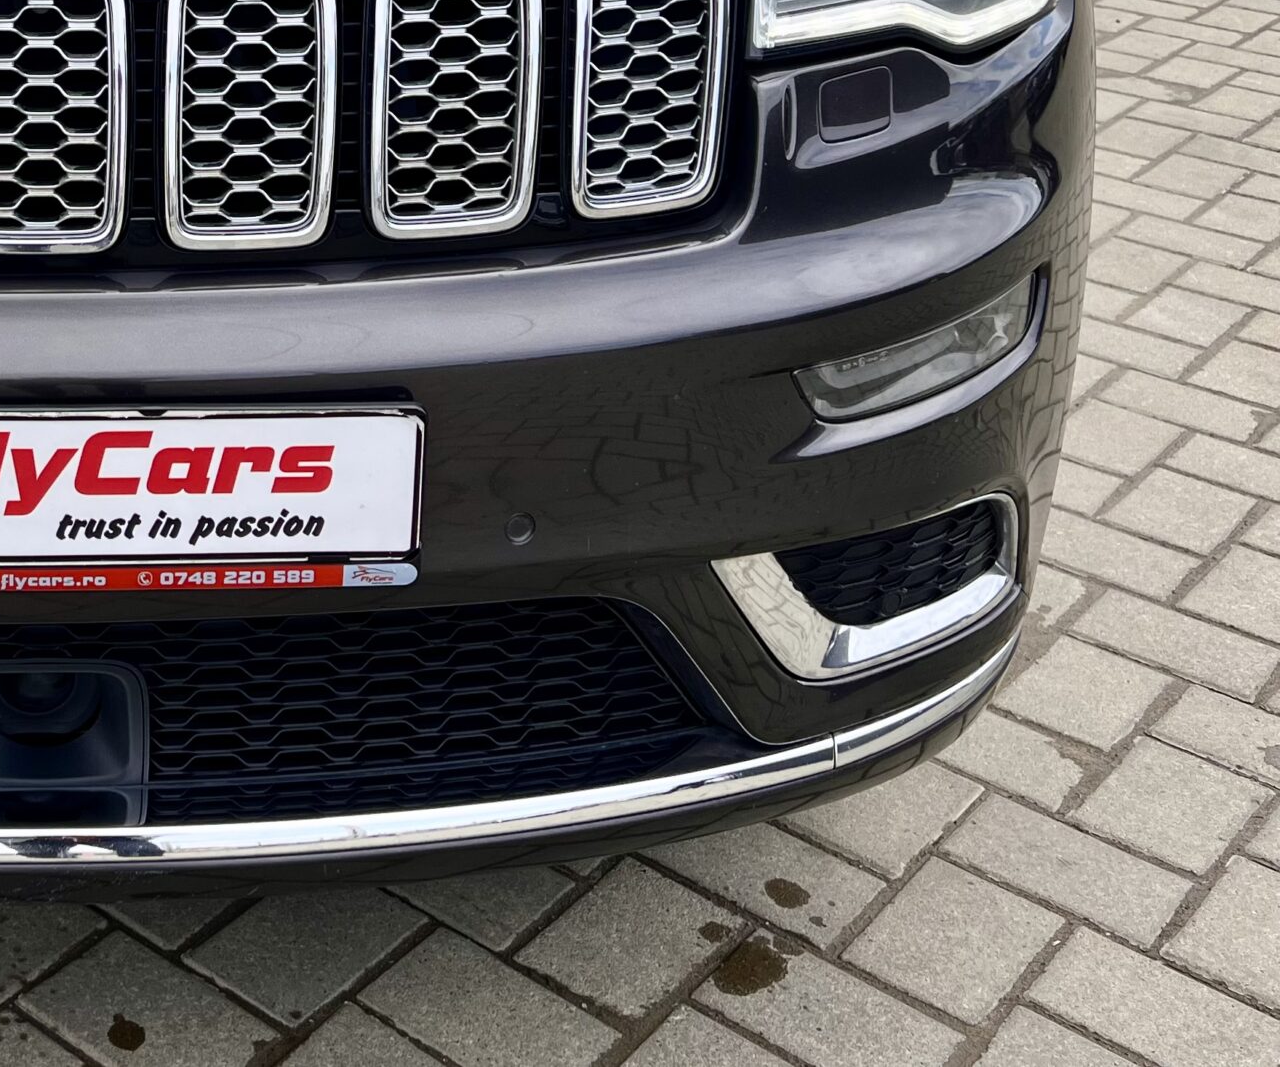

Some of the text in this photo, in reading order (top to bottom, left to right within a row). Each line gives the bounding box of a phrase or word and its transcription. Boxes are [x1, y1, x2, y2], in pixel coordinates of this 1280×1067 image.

[55, 508, 326, 546] trust in passion
[159, 571, 217, 586] 0748
[223, 570, 266, 585] 220
[272, 569, 315, 584] 589
